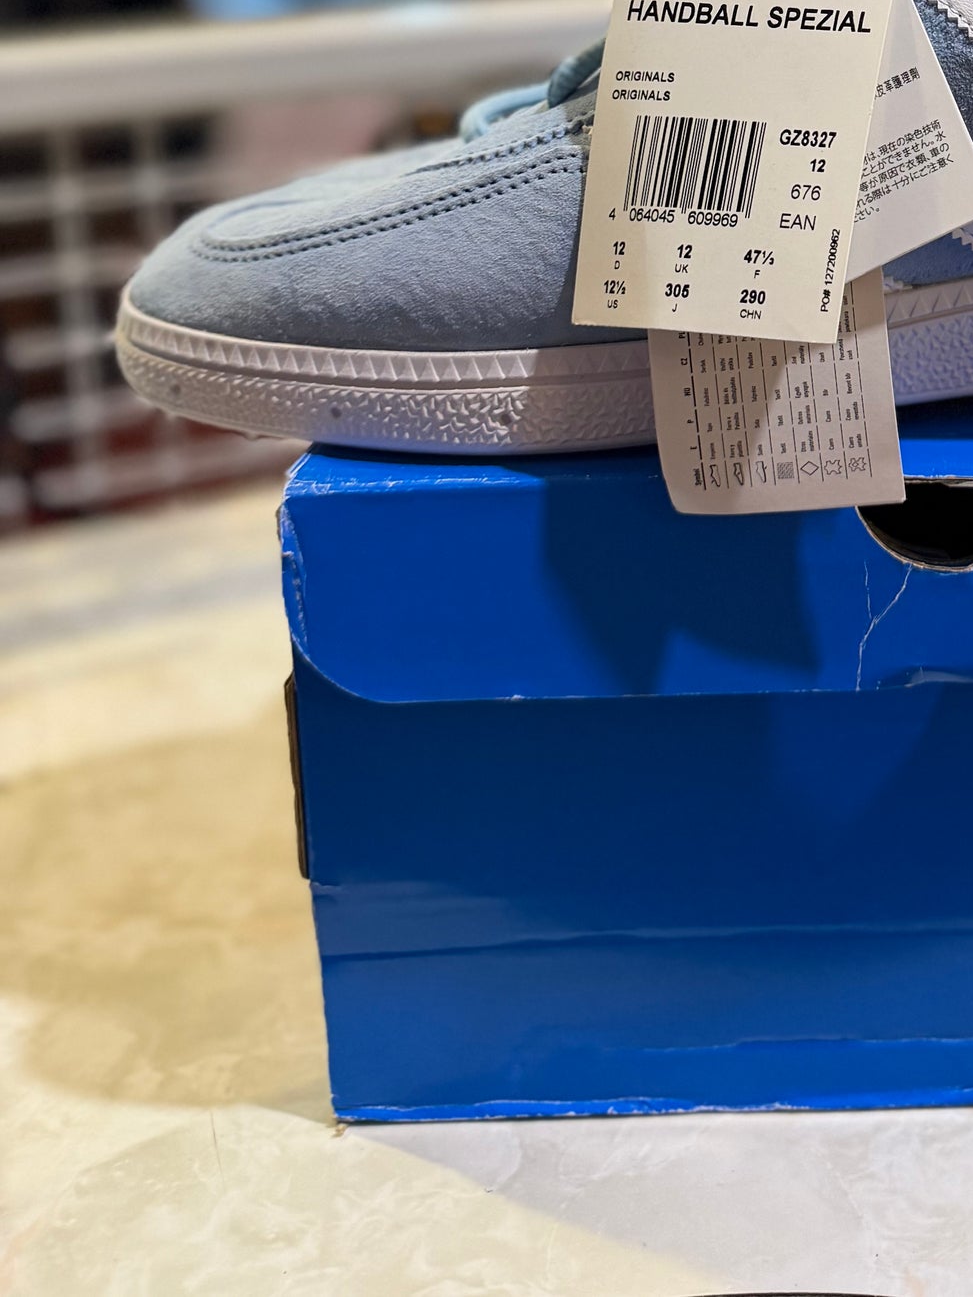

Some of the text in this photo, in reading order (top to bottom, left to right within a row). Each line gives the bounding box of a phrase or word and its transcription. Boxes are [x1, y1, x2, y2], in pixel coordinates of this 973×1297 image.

[627, 0, 871, 33] HANDBALL SPEZIAL
[615, 71, 675, 83] ORIGINALS
[612, 89, 671, 101] ORIGINALS
[780, 129, 837, 149] GZ8327
[810, 159, 826, 173] 12
[790, 184, 821, 200] 676
[608, 208, 738, 228] 4 064045 609969
[779, 214, 817, 231] EAN
[612, 241, 626, 256] 12
[677, 244, 693, 259] 12
[614, 260, 760, 279] D UK F
[820, 228, 840, 312] PO# 127200962
[664, 283, 690, 298] 305
[740, 289, 766, 305] 290
[607, 300, 762, 320] US J CHN
